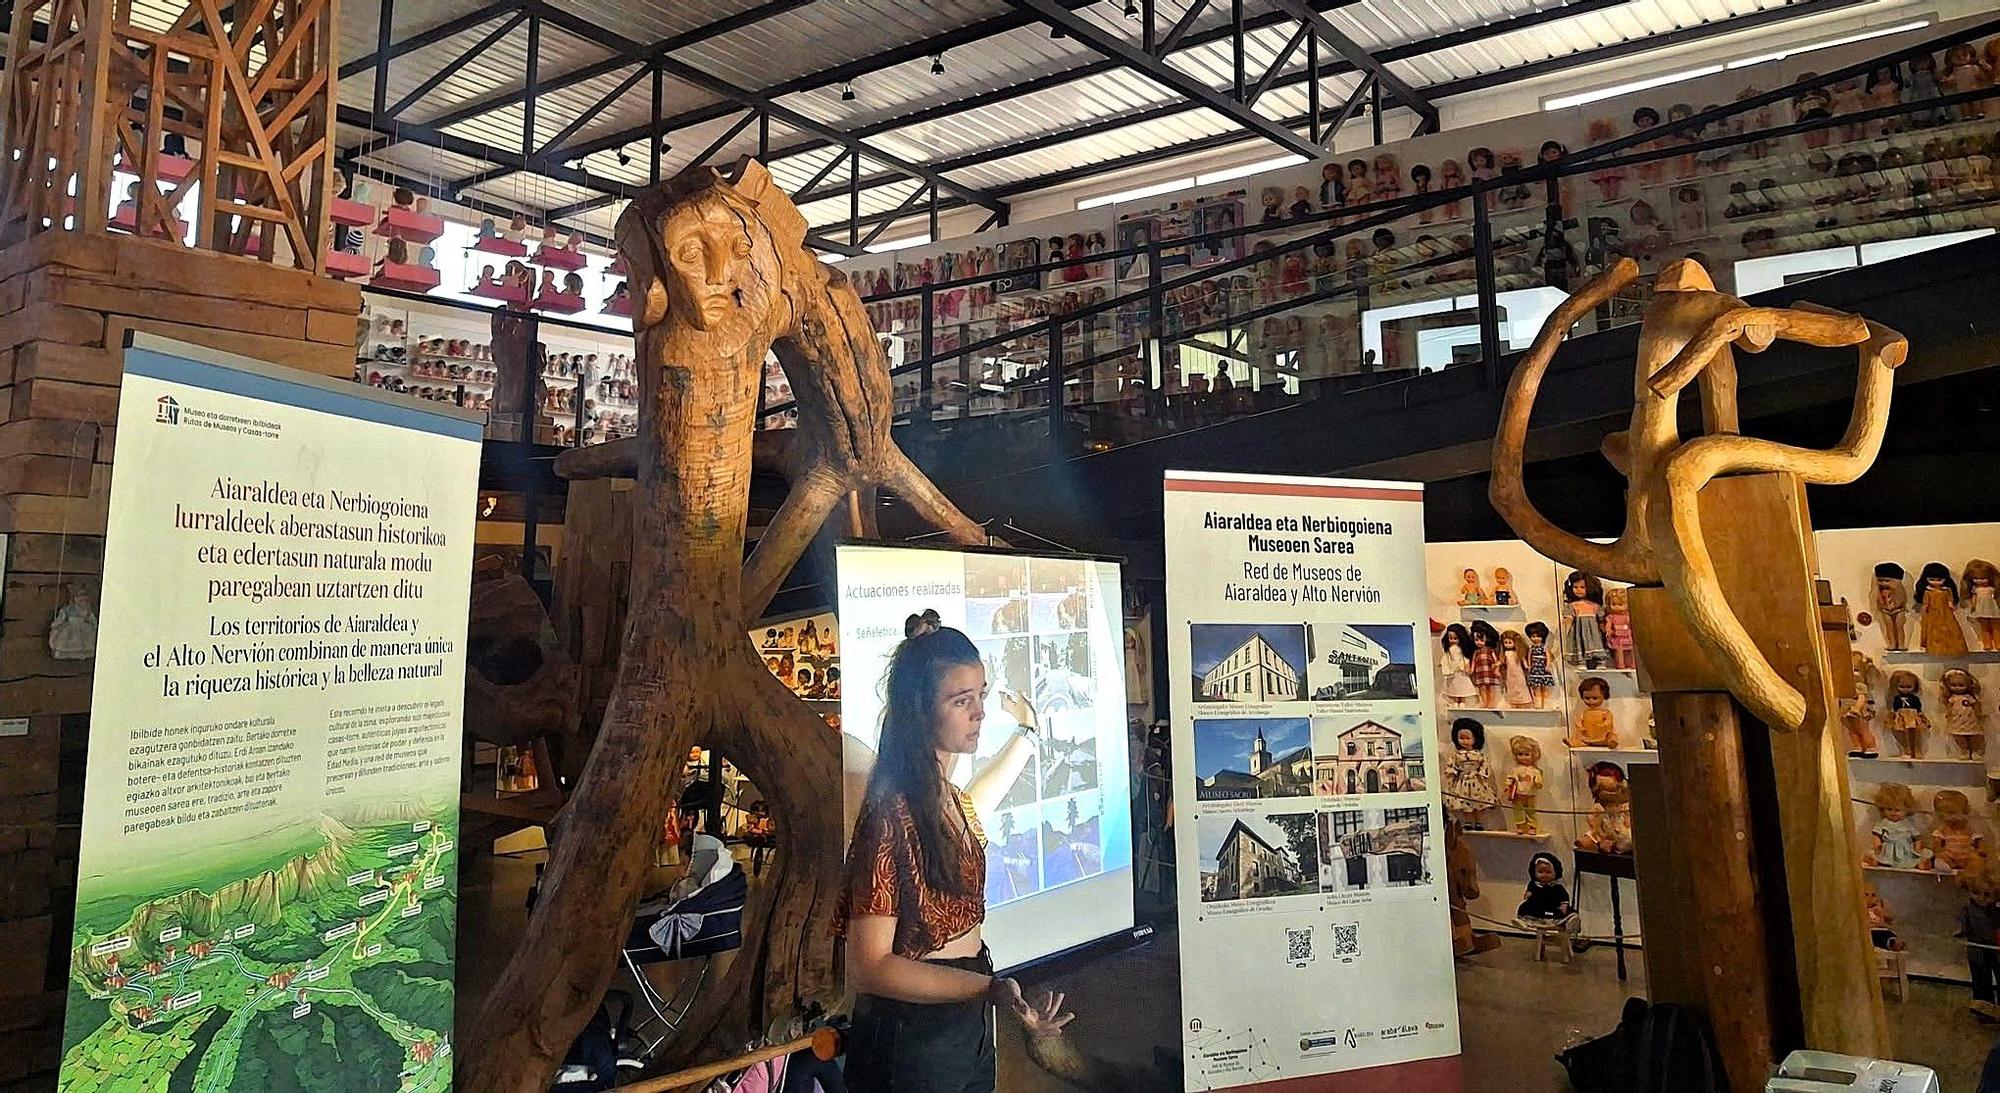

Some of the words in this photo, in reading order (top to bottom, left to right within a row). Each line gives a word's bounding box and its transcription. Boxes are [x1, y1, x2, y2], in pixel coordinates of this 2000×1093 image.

[184, 407, 205, 417] Museo
[219, 413, 251, 426] dorretxeen
[183, 417, 202, 427] Rutas
[213, 422, 236, 432] Museos
[243, 427, 279, 439] Casas-torre
[211, 477, 298, 507] Aiaraldea
[302, 490, 325, 510] eta
[329, 489, 429, 522] Nerbiogoiena
[175, 503, 275, 535] lurraldeek
[280, 515, 373, 543] aberastasun
[378, 521, 447, 547] historikoa
[1204, 512, 1272, 531] Aiaraldea
[1276, 516, 1298, 532] eta
[1303, 516, 1392, 537] Nerbiogoiena
[1249, 535, 1310, 553] Museoen
[1314, 537, 1354, 554] Sarea
[198, 542, 228, 565] eta
[233, 541, 318, 569] edertasun
[323, 549, 386, 571] naturala
[391, 551, 432, 573] modu
[1244, 562, 1269, 580] Red
[1273, 563, 1288, 579] de
[1293, 563, 1342, 581] Museos
[1346, 564, 1362, 581] de
[208, 575, 312, 603] paregabean
[316, 580, 389, 599] uztartzen
[393, 578, 423, 599] ditu
[846, 585, 908, 599] Actuaciones
[912, 582, 960, 595] realizadas
[1225, 583, 1287, 601] Aiaraldea
[1290, 589, 1298, 606] y
[1303, 585, 1327, 602] Alto
[1332, 585, 1381, 603] Nervión
[210, 615, 240, 637] Los
[245, 614, 320, 635] territorios
[323, 613, 342, 634] de
[345, 614, 408, 633] Aiaraldea
[411, 618, 419, 636] y
[144, 645, 161, 668] el
[166, 645, 206, 667] Alto
[211, 643, 275, 664] Nervión
[279, 639, 348, 662] combinan
[351, 639, 367, 658] de
[370, 640, 422, 657] manera
[425, 636, 453, 654] única
[163, 675, 180, 698] la
[186, 673, 251, 700] riqueza
[255, 669, 318, 690] histórica
[321, 671, 331, 690] y
[334, 664, 346, 685] la
[349, 663, 394, 683] belleza
[398, 659, 443, 679] natural
[130, 727, 162, 740] Ibilbide
[164, 725, 189, 738] honek
[190, 723, 223, 736] inguruko
[129, 740, 177, 757] ezagutzera
[128, 758, 165, 771] bikainak
[167, 754, 208, 768] ezagutuko
[162, 772, 176, 782] eta
[126, 789, 160, 803] egiazko
[162, 785, 185, 797] altxor
[125, 803, 166, 817] museoen
[168, 800, 190, 811] sarea
[124, 816, 175, 834] paregabeak
[177, 812, 197, 824] bildu
[198, 810, 210, 820] eta
